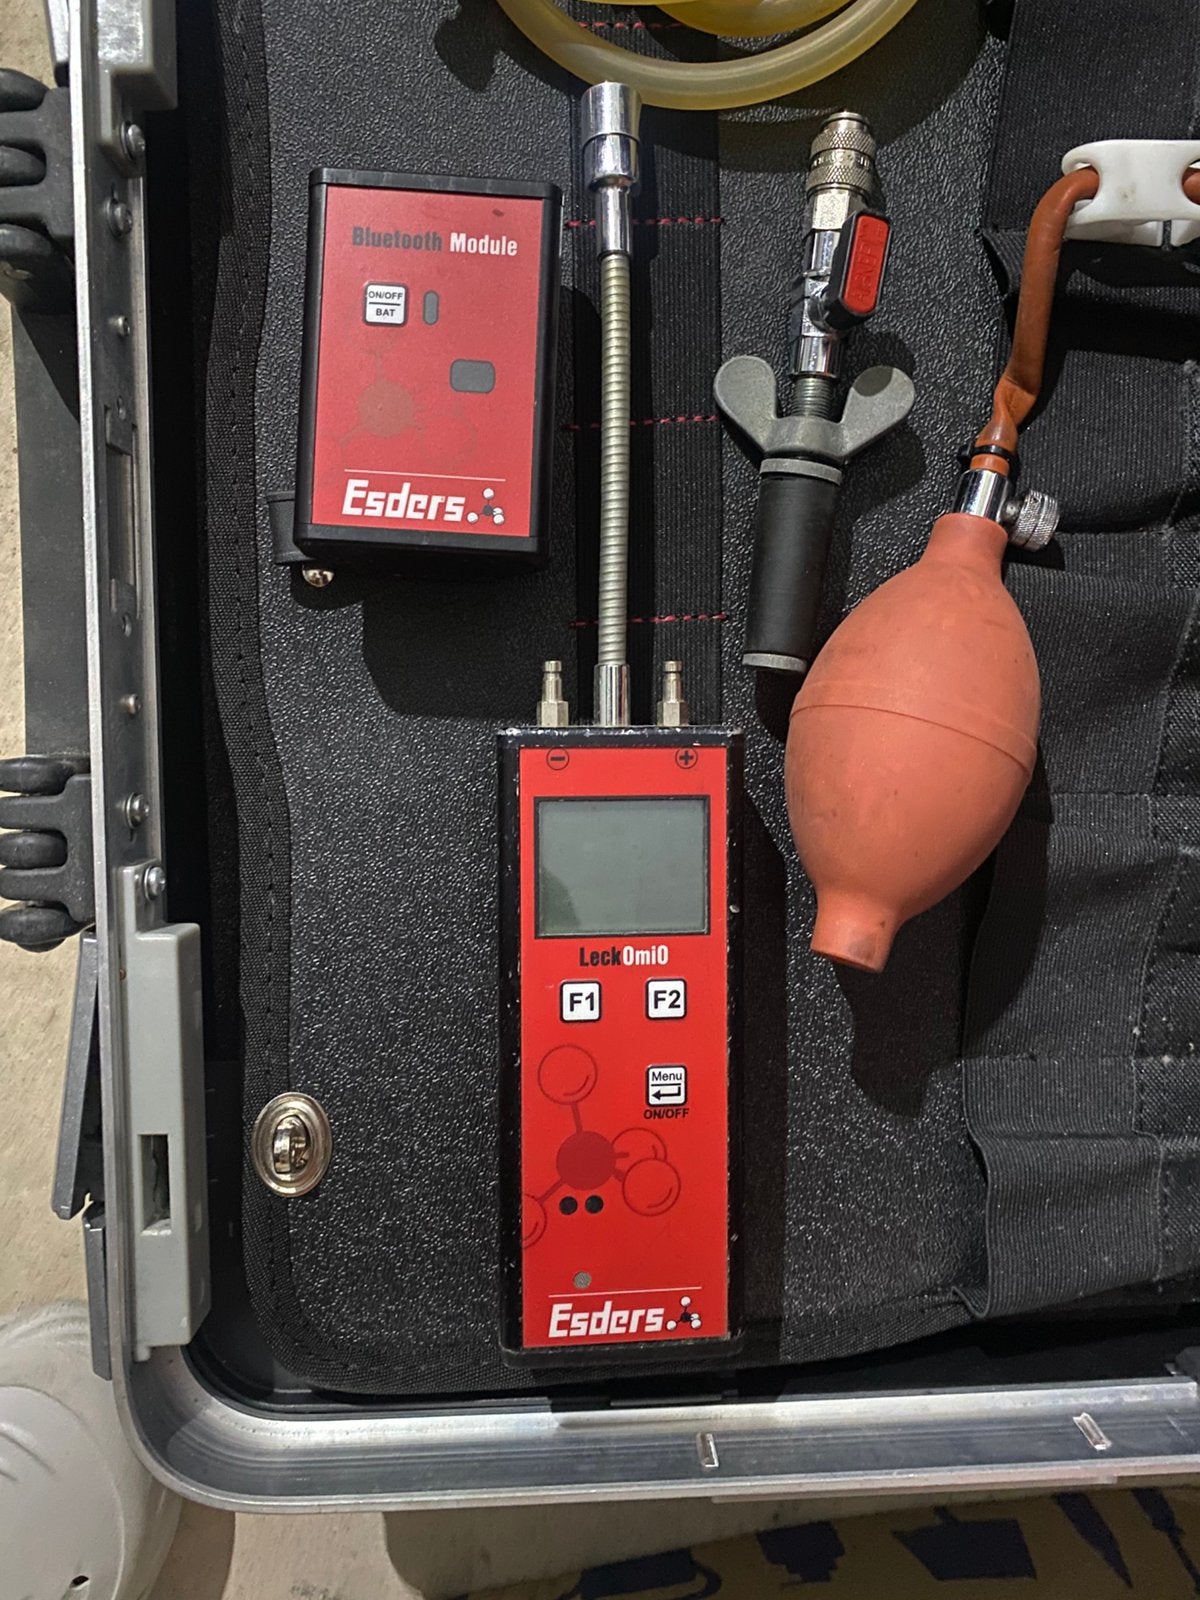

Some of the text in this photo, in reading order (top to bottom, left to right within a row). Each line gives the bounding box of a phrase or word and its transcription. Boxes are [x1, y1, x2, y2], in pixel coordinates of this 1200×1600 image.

[352, 226, 518, 256] Bluetooth Module
[368, 291, 403, 300] ON/OFF
[375, 308, 396, 317] BAT
[342, 479, 466, 522] Esders
[569, 992, 595, 1012] F1
[653, 990, 681, 1009] F2
[651, 1071, 682, 1081] Menu
[643, 1108, 690, 1119] ON/OFF
[548, 1300, 665, 1338] Esders
